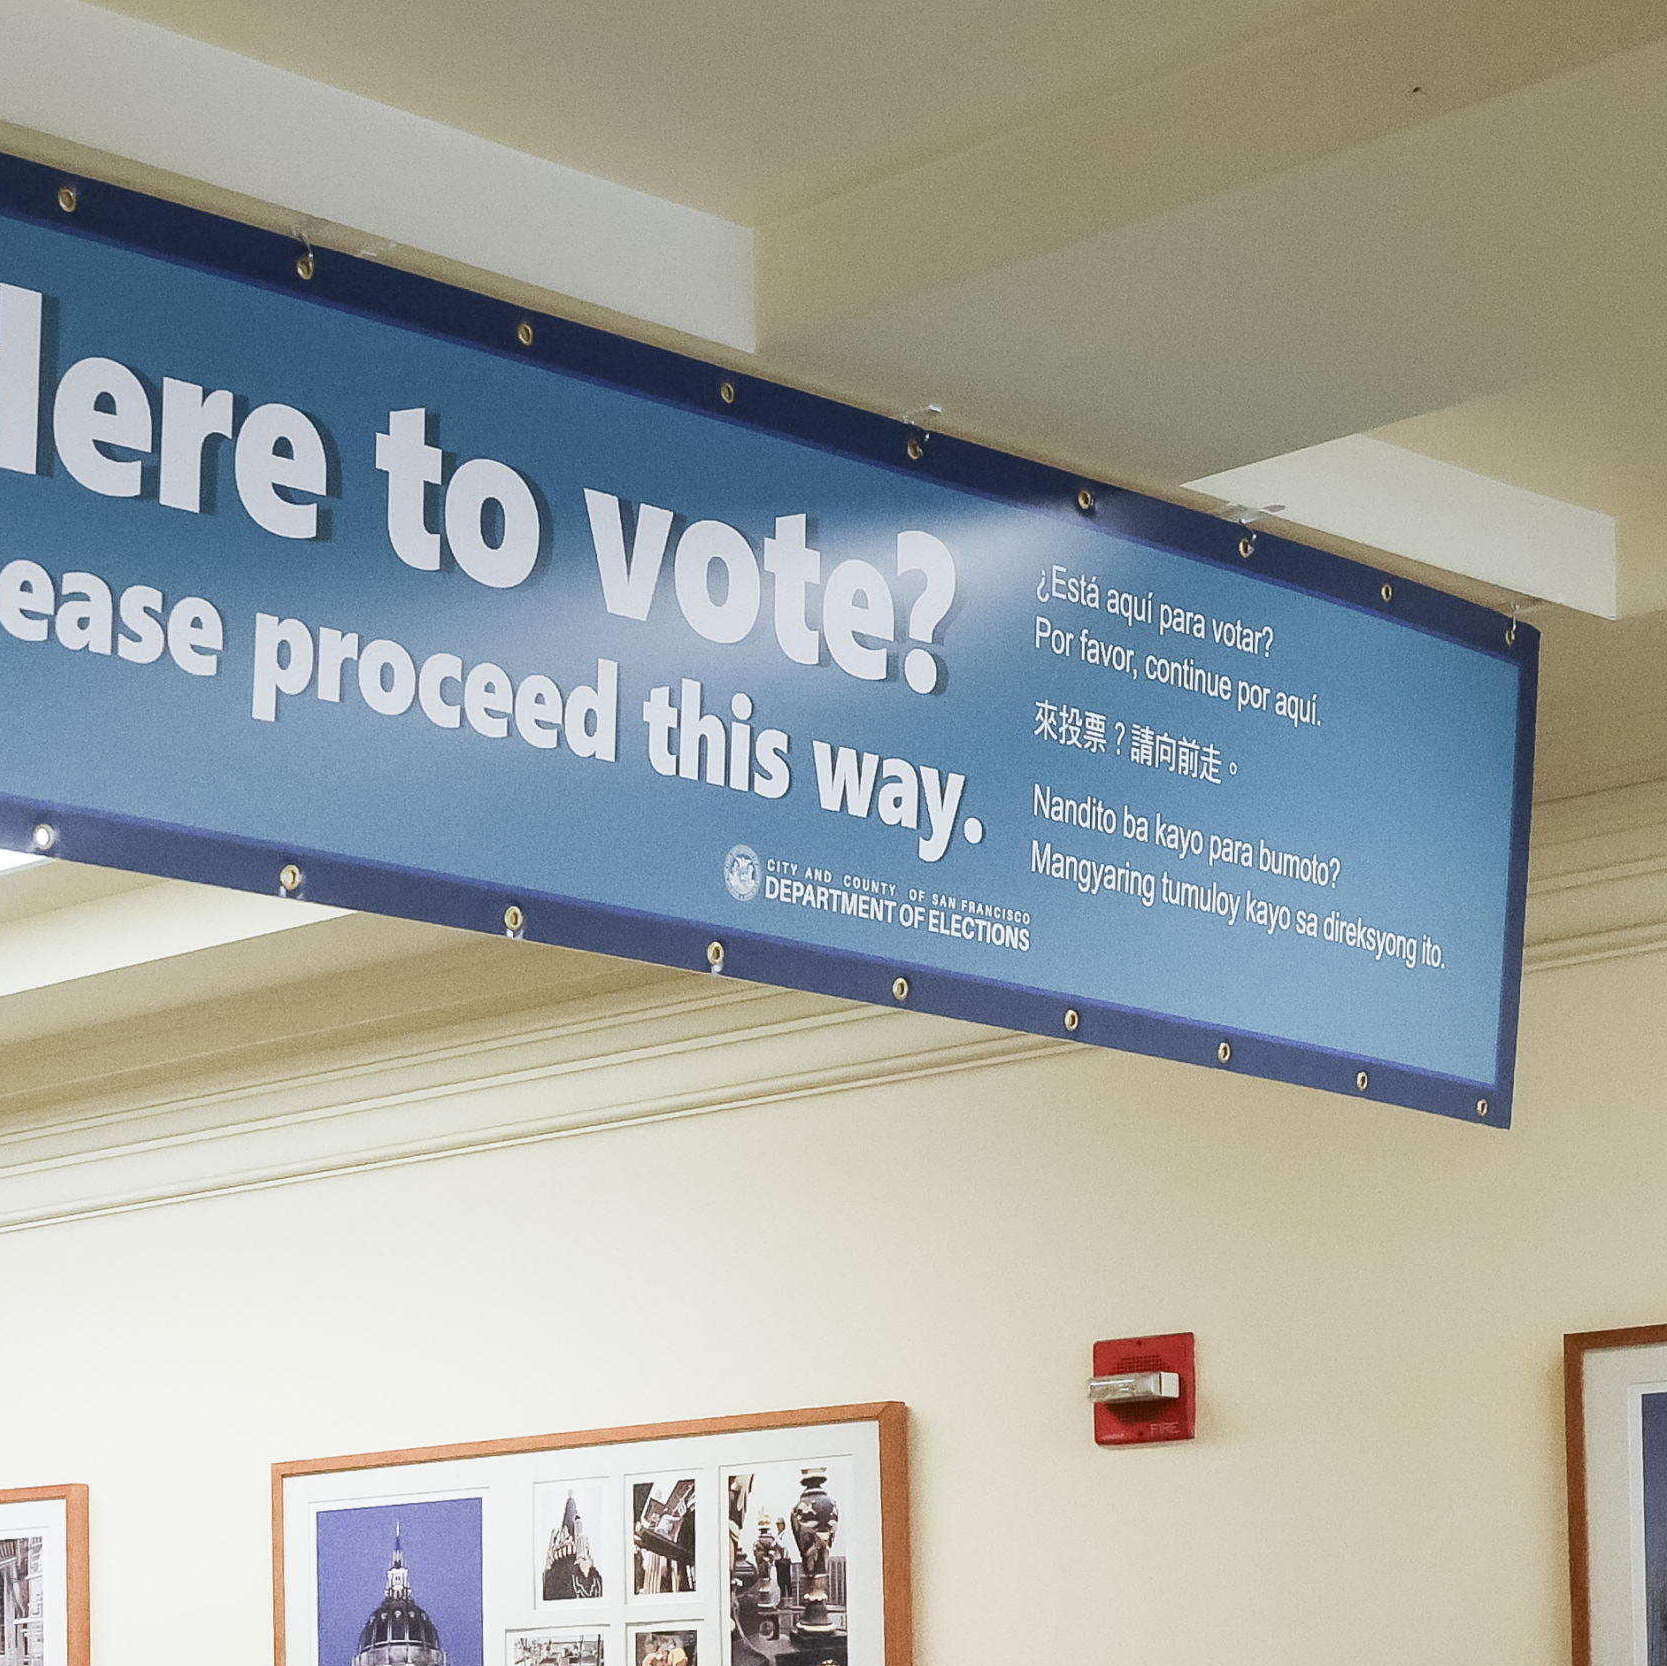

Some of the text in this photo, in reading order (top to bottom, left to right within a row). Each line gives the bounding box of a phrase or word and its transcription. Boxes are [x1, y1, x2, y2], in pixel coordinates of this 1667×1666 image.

[375, 406, 542, 590] to
[582, 484, 958, 695] vote?
[1036, 565, 1273, 657] ¿Está aquí para votar?
[1036, 616, 1320, 726] Por favor, continue por aquí.
[252, 610, 619, 765] proceed
[643, 678, 791, 800] this
[812, 739, 984, 863] way.
[1034, 784, 1340, 888] Nandito ba kayo para bumoto?
[766, 876, 1029, 951] DEPARTMENT OF ELECTIONS
[768, 859, 1030, 924] CITY AND COUNTY OF SAN FRANCISCO
[1032, 840, 1444, 968] Mangyaring tumuloy kayo sa direksyong ito.
